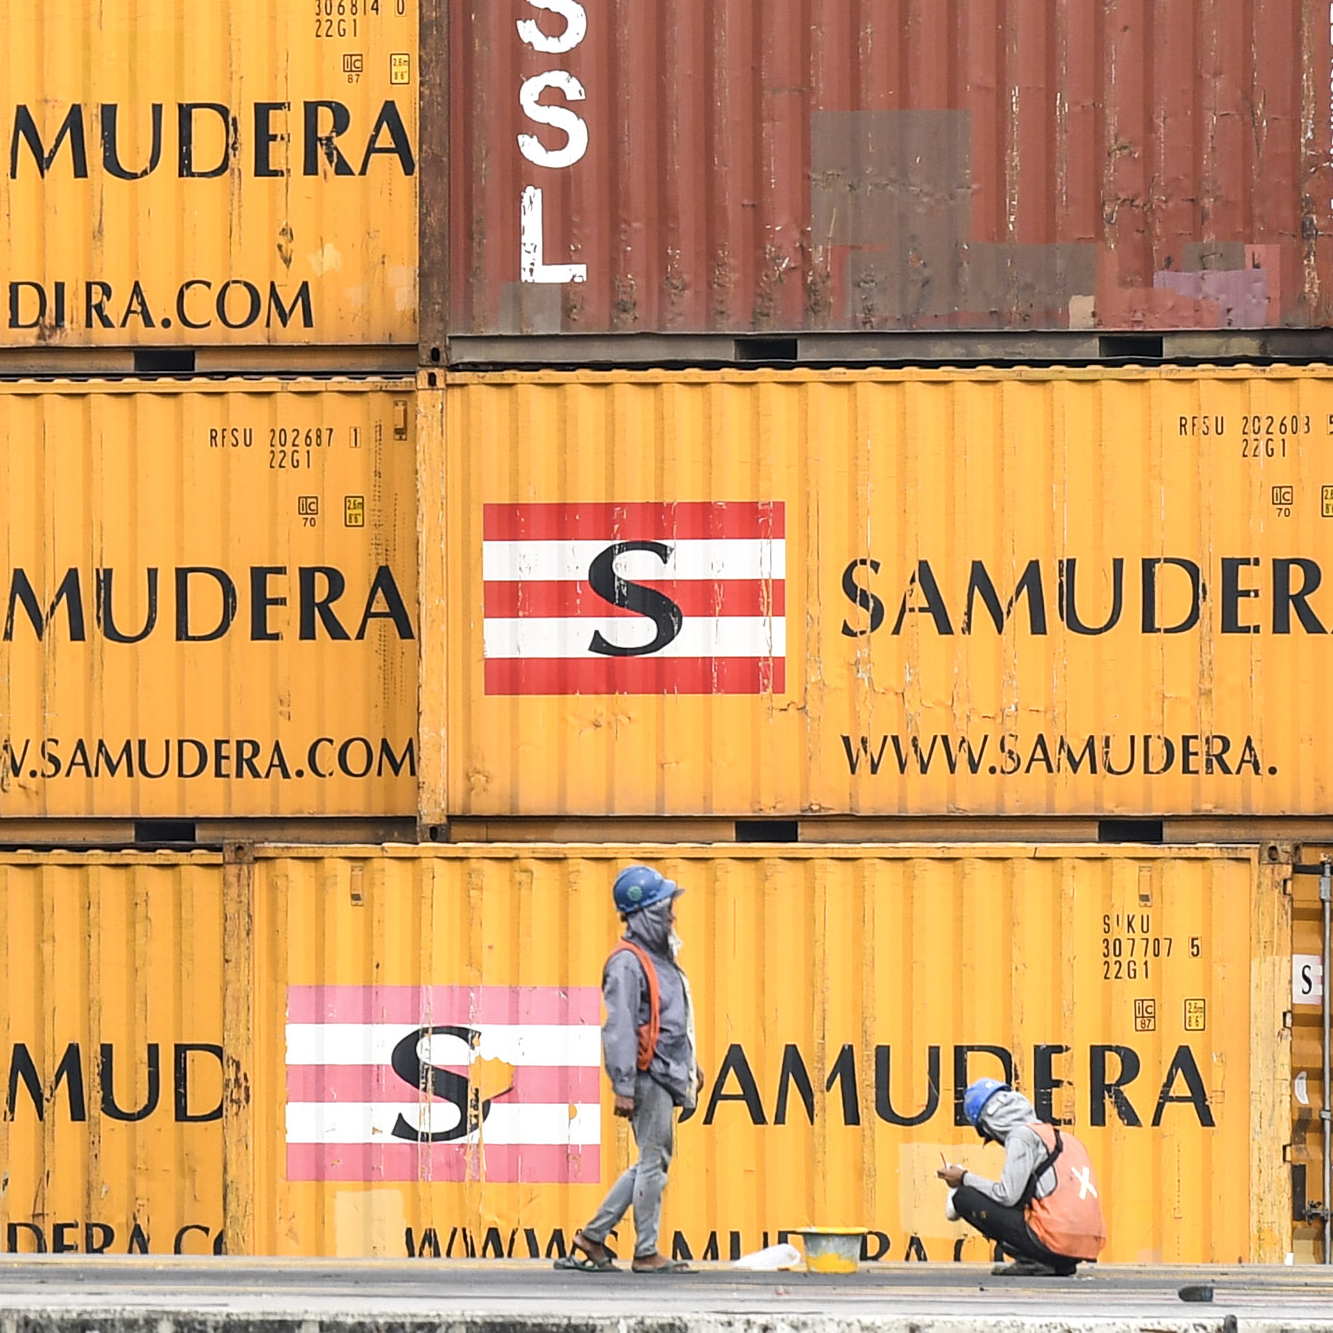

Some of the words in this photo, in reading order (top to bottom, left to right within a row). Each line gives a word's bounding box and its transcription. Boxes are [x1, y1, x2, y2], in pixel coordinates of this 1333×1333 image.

[315, 18, 357, 38] 22G1
[347, 74, 361, 84] 87
[1179, 416, 1224, 436] RFSU
[210, 427, 253, 448] RFSU
[269, 427, 334, 448] 202687
[1242, 438, 1286, 457] 22G1
[269, 450, 311, 469] 22G1
[302, 517, 317, 528] 70
[1276, 508, 1291, 518] 70
[587, 540, 684, 656] S
[841, 557, 1333, 636] SAMUDER
[1102, 937, 1174, 958] 307707
[1189, 937, 1201, 958] 5
[1103, 960, 1150, 980] 22G1
[1301, 964, 1314, 996] S
[1139, 1019, 1153, 1030] 87
[678, 1043, 1217, 1129] AMUDERA
